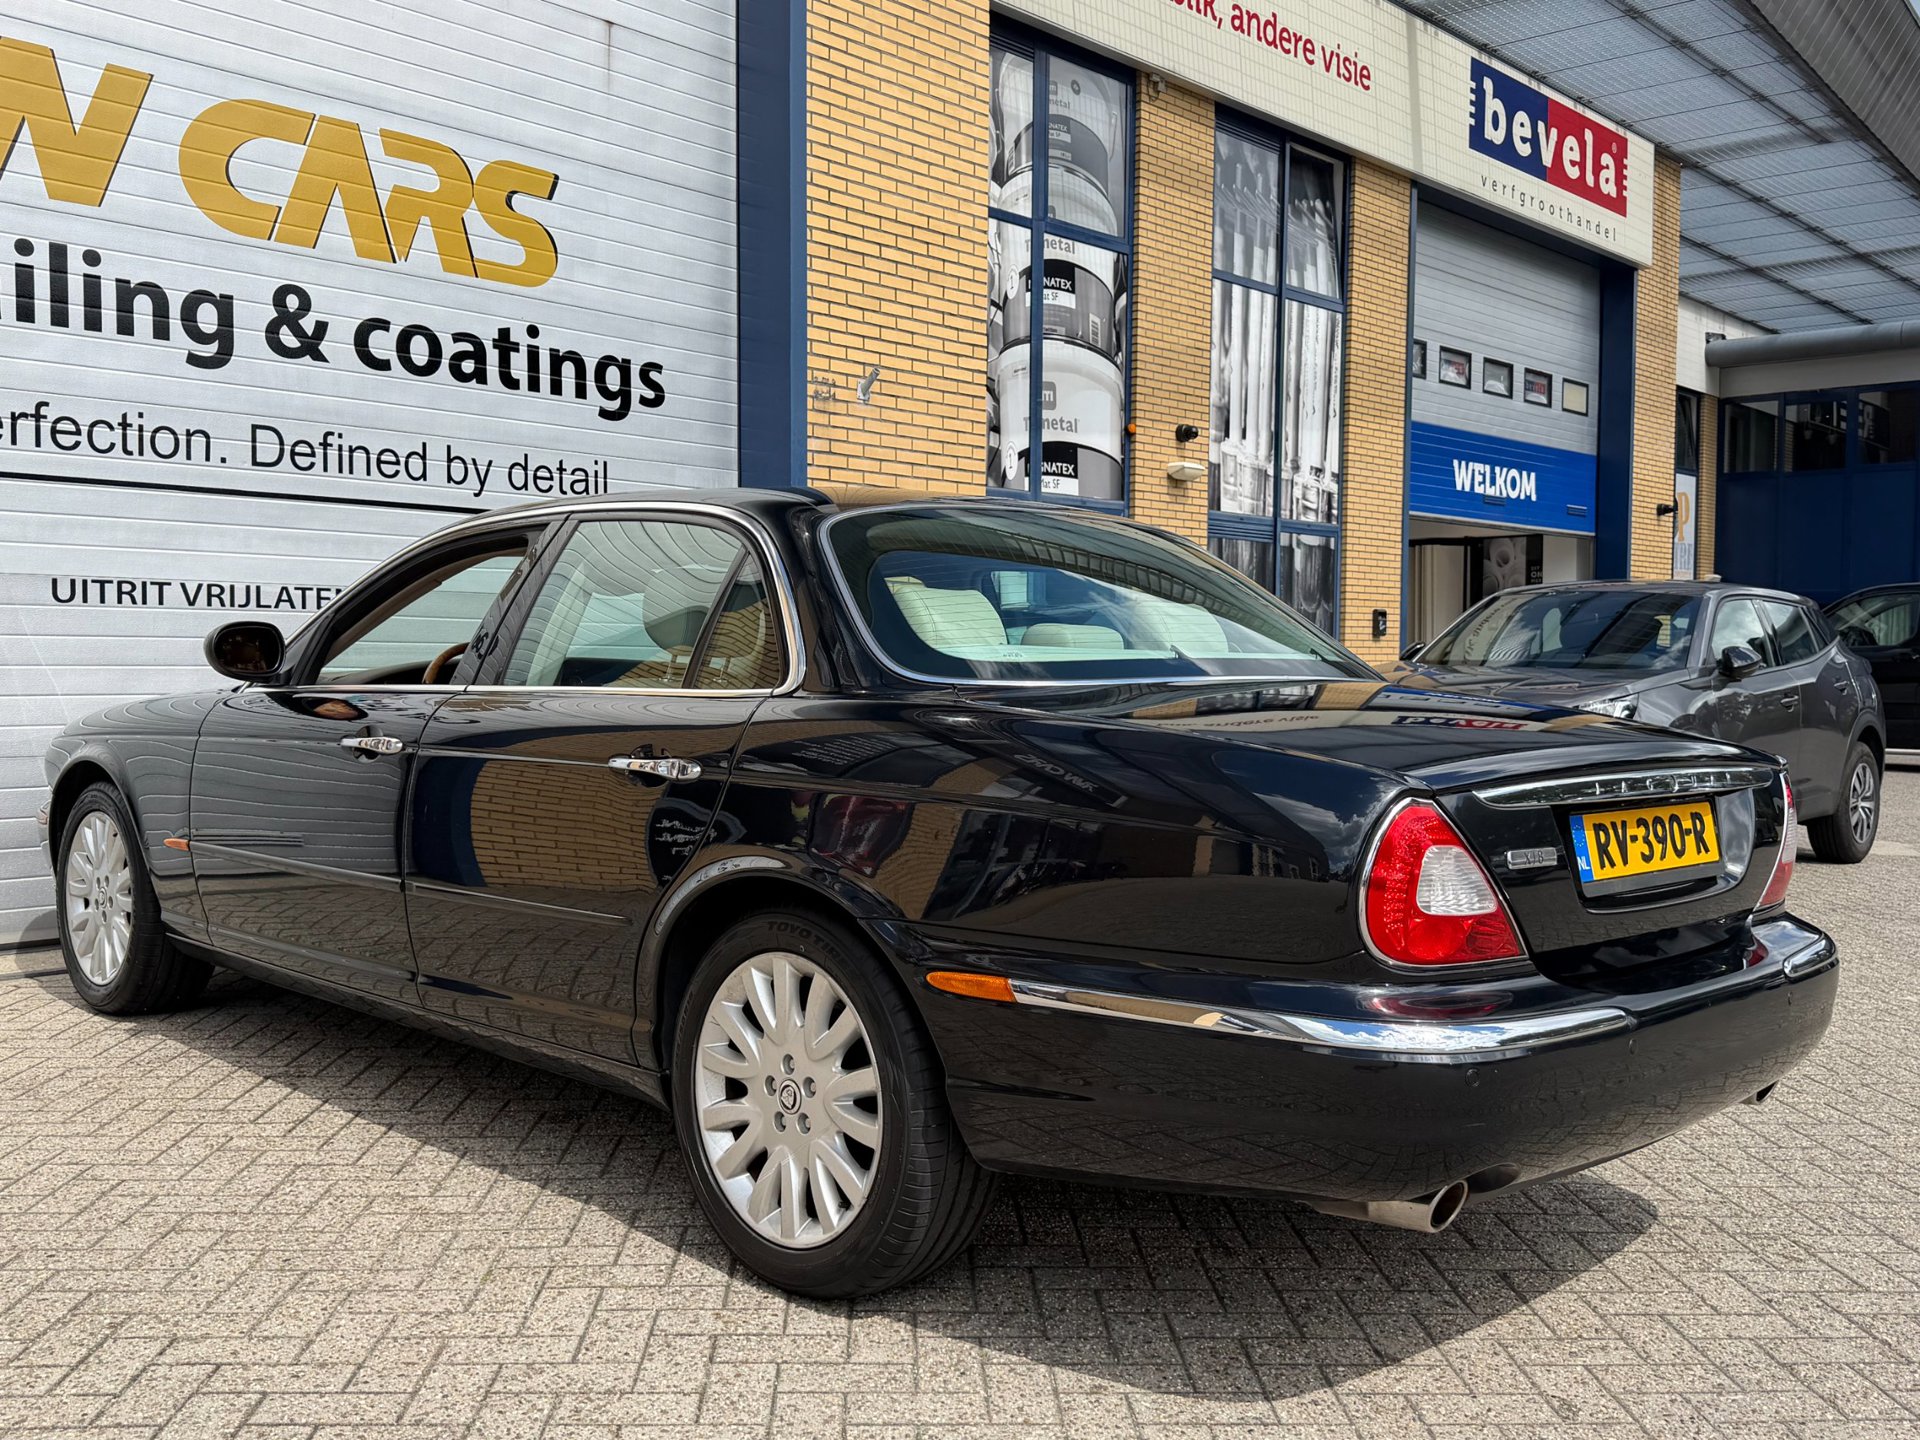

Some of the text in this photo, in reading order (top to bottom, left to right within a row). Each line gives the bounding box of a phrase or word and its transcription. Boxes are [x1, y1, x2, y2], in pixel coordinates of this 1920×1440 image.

[1231, 4, 1315, 66] andere
[1321, 44, 1371, 91] visie
[1483, 76, 1617, 198] bevela
[178, 99, 559, 288] CARS
[1481, 175, 1616, 242] verfgroothandel
[0, 238, 666, 422] iling & coatings
[0, 401, 608, 498] rfection. Defined by detail
[1453, 459, 1537, 502] WELKOM
[51, 578, 342, 610] UITRIT VRIJLATE
[1577, 856, 1591, 870] NL
[1592, 811, 1710, 870] RV-390-R
[768, 920, 811, 938] TOYO
